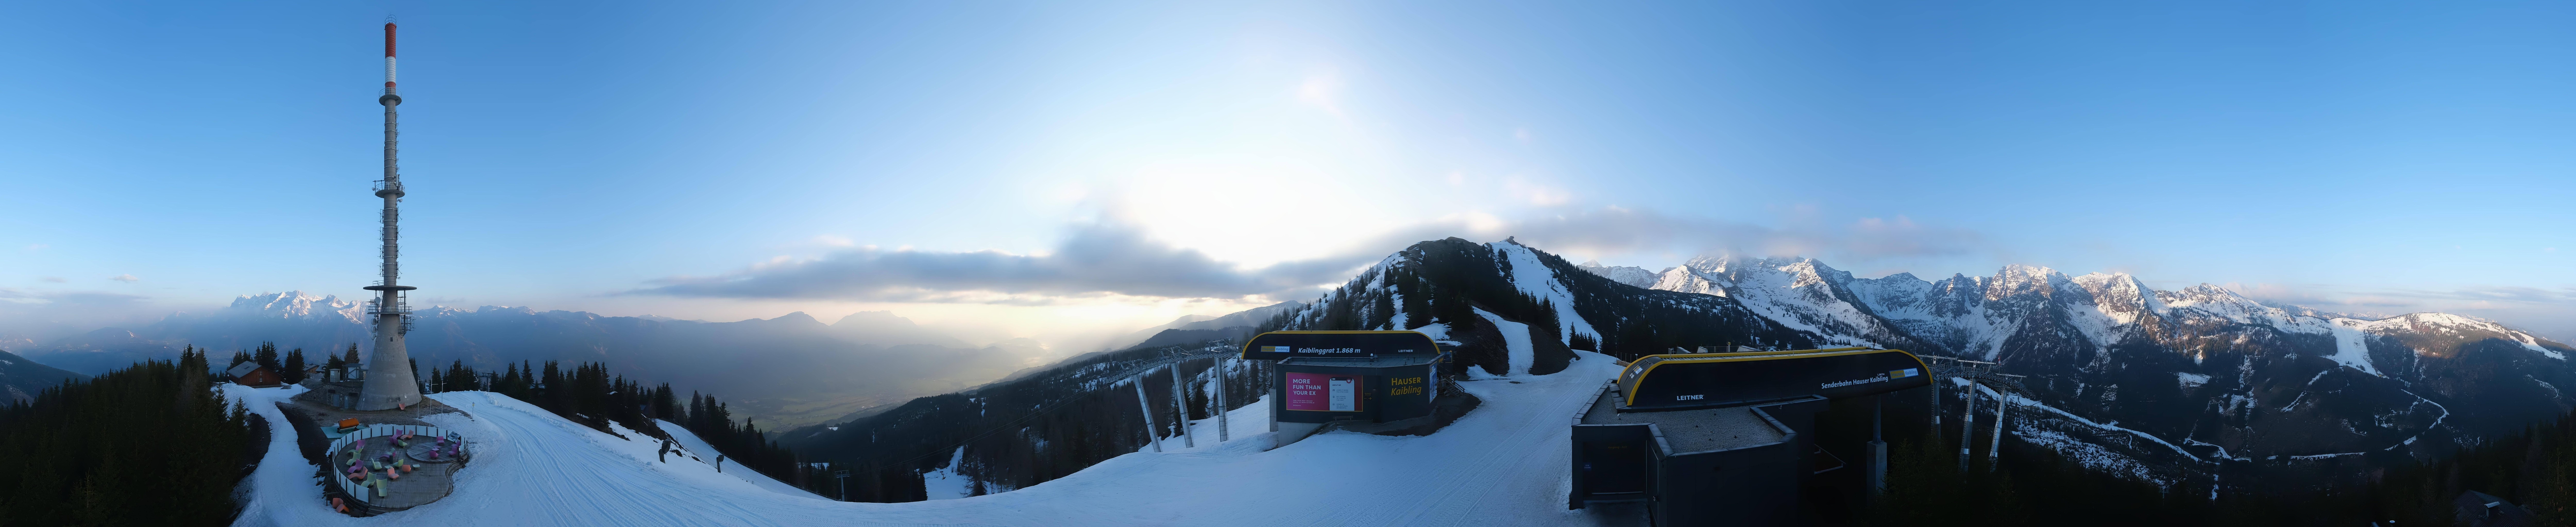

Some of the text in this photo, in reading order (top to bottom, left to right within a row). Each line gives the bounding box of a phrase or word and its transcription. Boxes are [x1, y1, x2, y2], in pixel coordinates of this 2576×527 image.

[1392, 377, 1421, 386] HAUSER
[1821, 380, 1852, 389] Senderbahn
[1391, 386, 1421, 396] Kaibling
